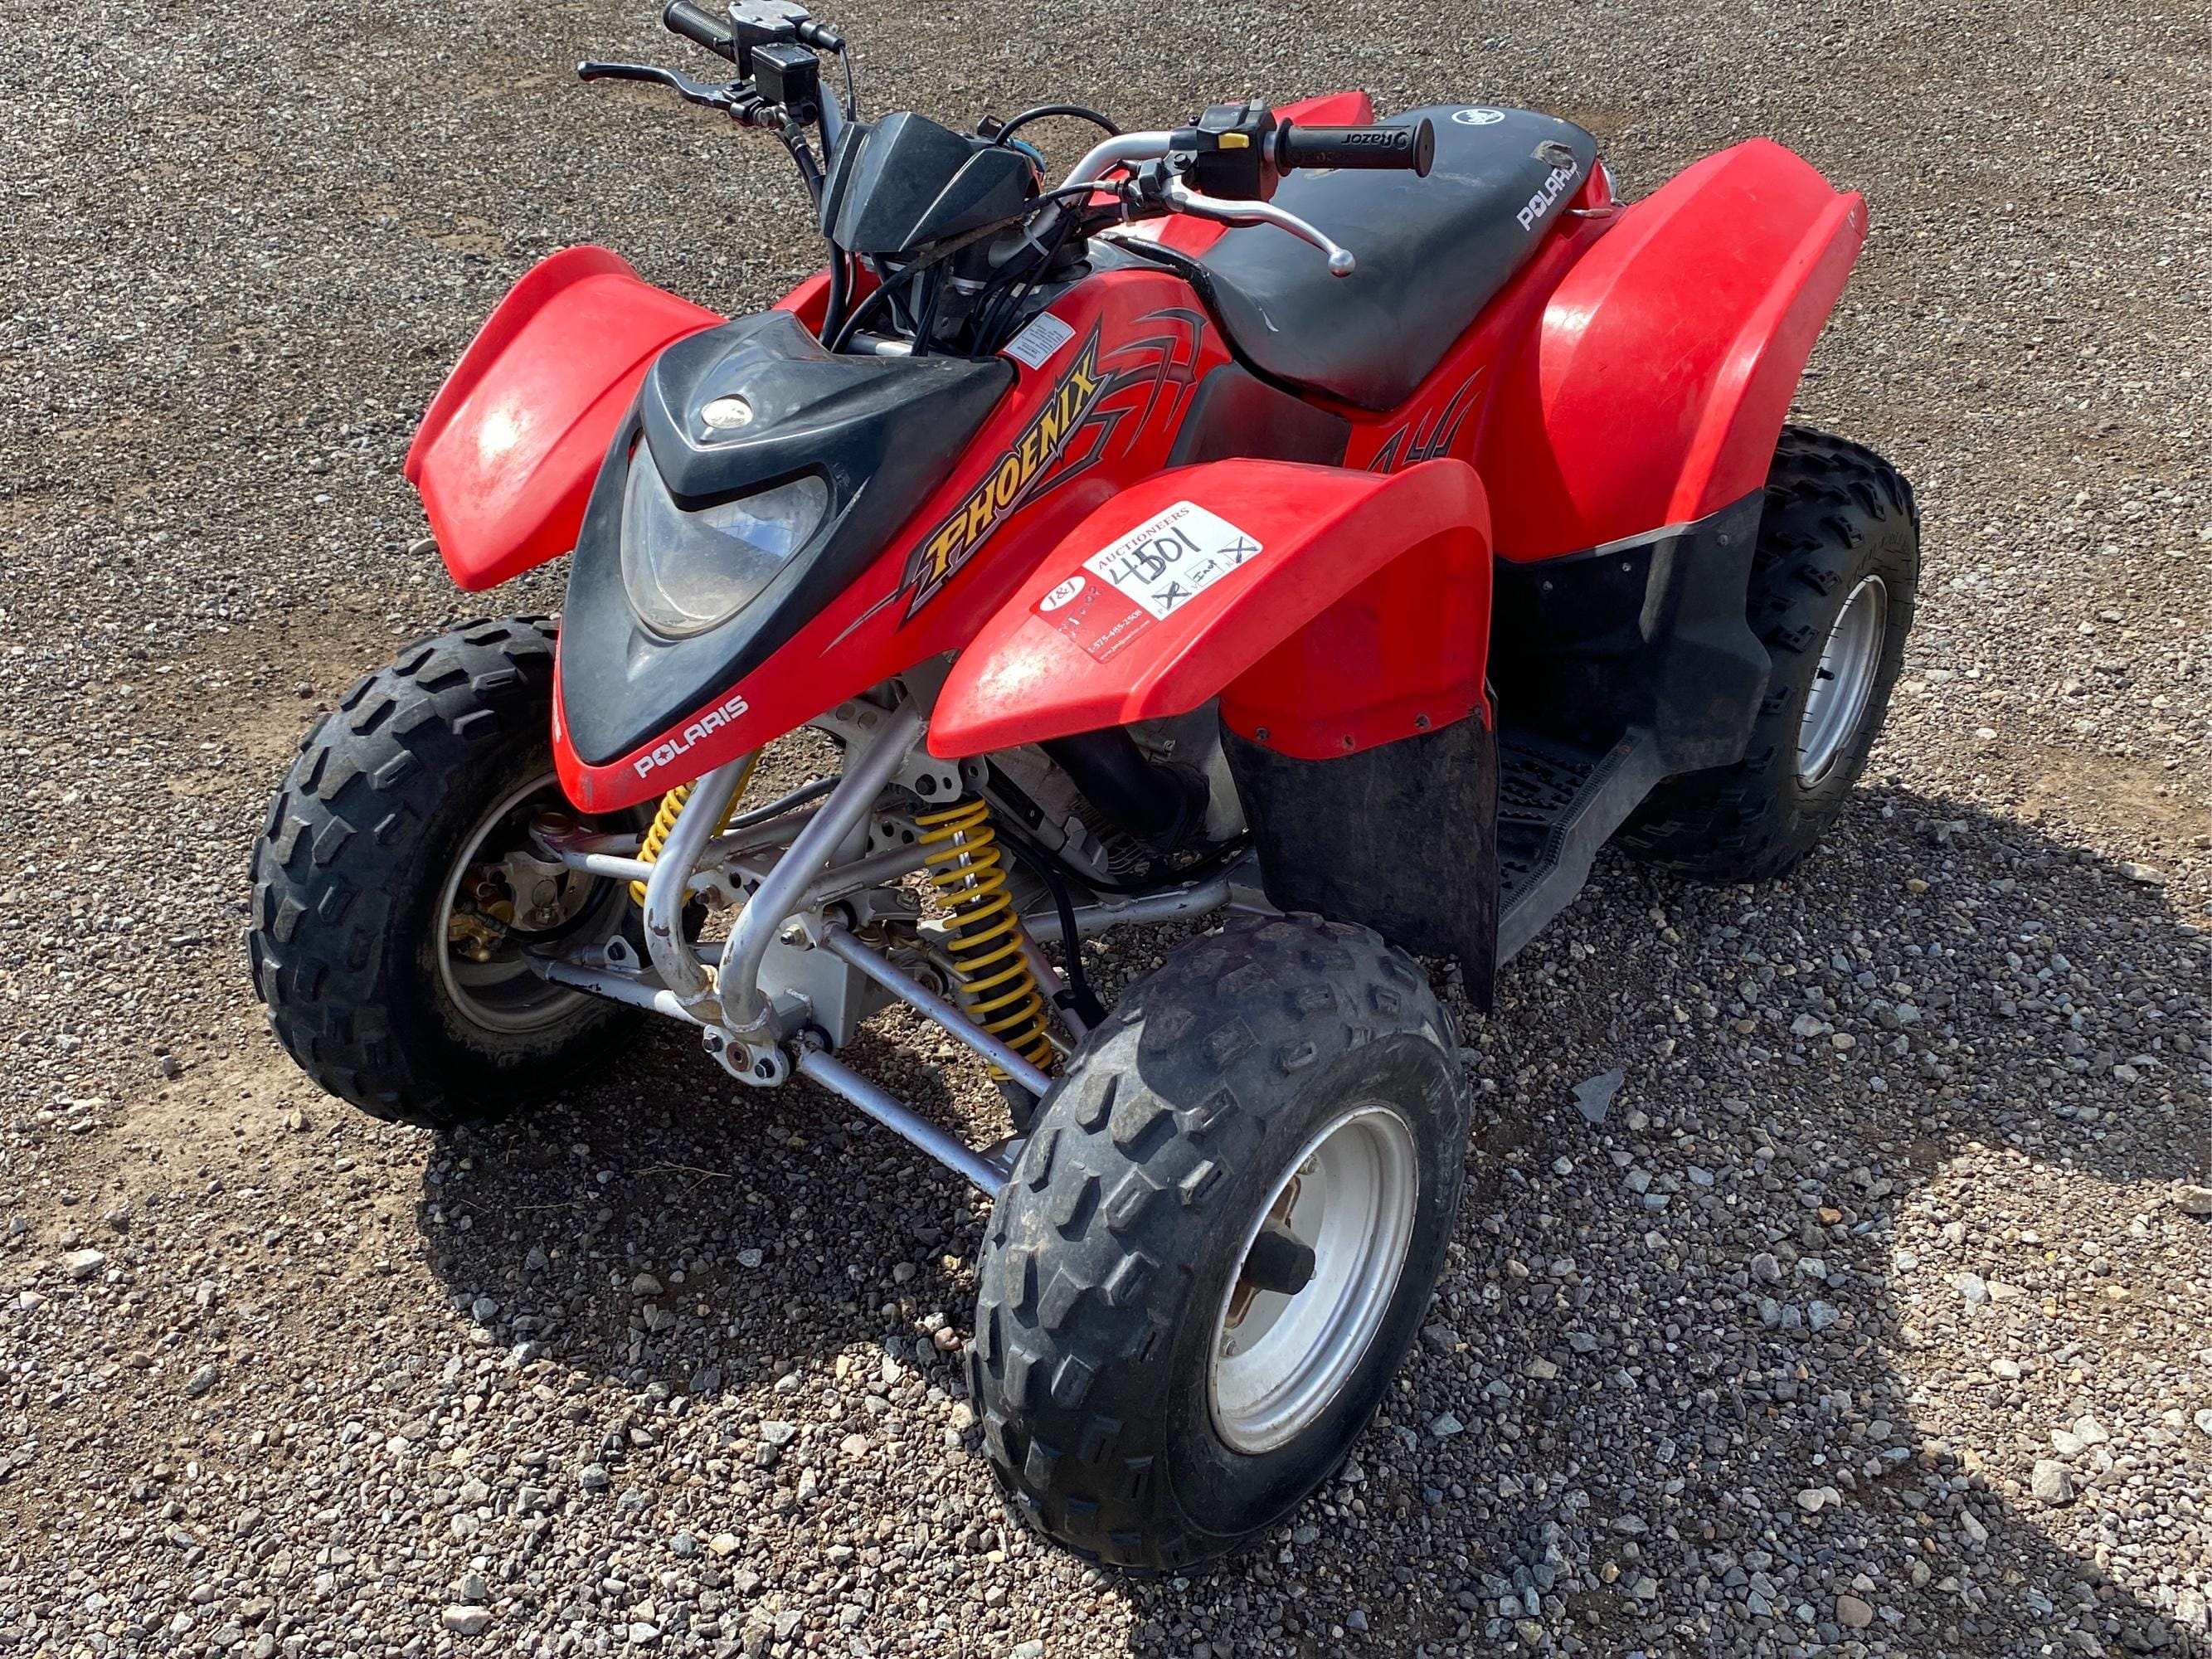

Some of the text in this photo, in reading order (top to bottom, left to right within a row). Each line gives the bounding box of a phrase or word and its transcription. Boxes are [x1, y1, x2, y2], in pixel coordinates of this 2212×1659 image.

[1342, 130, 1395, 148] Razor
[926, 353, 1096, 581] PHOENIX
[1097, 507, 1189, 570] AUCTIONEERS
[1109, 526, 1201, 585] 4501
[634, 695, 749, 779] POLARIS
